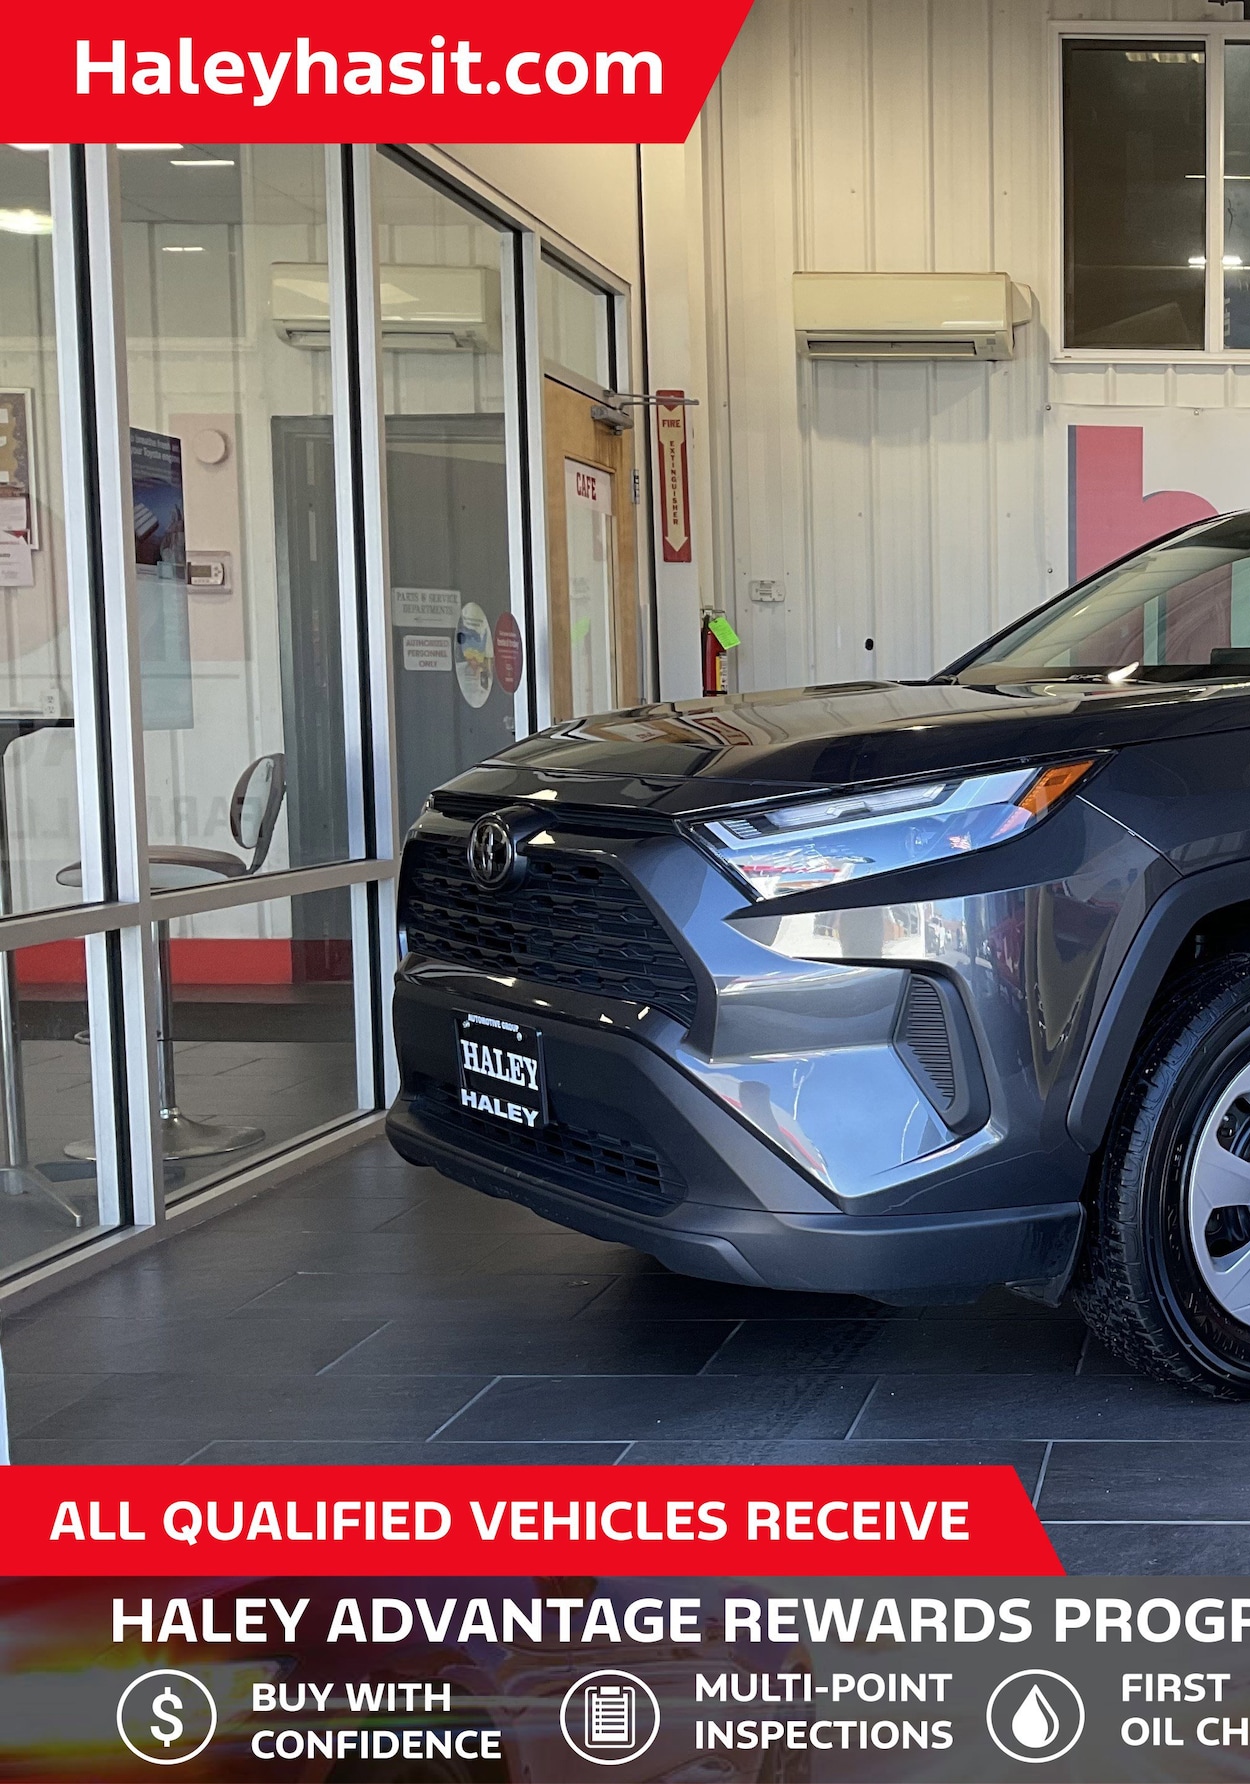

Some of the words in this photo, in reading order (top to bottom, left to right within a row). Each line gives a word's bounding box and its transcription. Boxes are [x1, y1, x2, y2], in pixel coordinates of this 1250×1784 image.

[661, 419, 681, 429] FIRE
[576, 471, 597, 501] CAFE
[669, 440, 679, 526] EXTINGUISHER
[397, 592, 419, 602] PARTS
[428, 592, 459, 604] SERVICE
[402, 604, 454, 616] DEPARTMENTS
[406, 639, 450, 648] AUTHORIZED
[407, 649, 449, 658] PERSONNEL
[418, 659, 439, 668] ONLY
[460, 1038, 539, 1091] HALEY
[460, 1087, 540, 1128] HALEY
